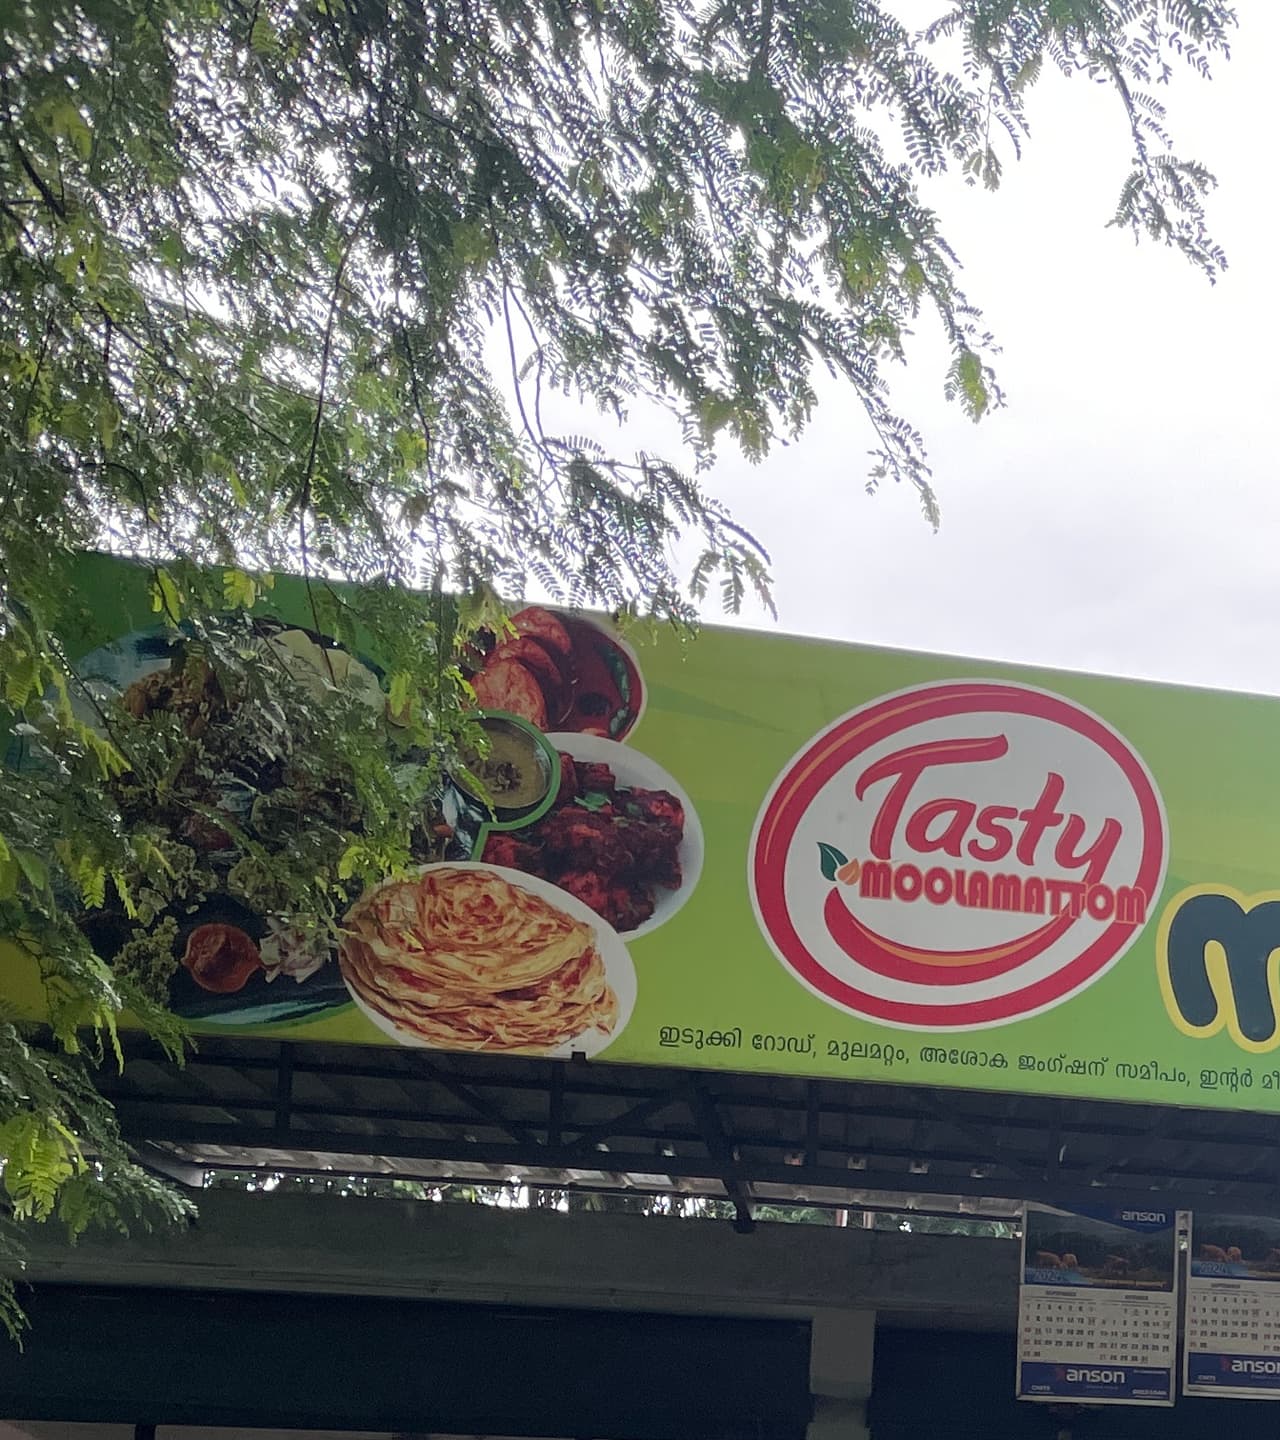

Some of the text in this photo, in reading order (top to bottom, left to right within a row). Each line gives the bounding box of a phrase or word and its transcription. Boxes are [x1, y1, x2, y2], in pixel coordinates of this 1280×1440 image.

[855, 734, 1122, 882] Tasty
[858, 859, 1147, 925] MOOLAMATTOM
[659, 1025, 742, 1050] ഇടുക്കി
[752, 1032, 816, 1058] റോഡ്,
[920, 1045, 1008, 1069] അശോക
[1115, 1060, 1190, 1087] സമീപം,
[1121, 1208, 1166, 1223] anson
[1066, 1367, 1125, 1384] anson
